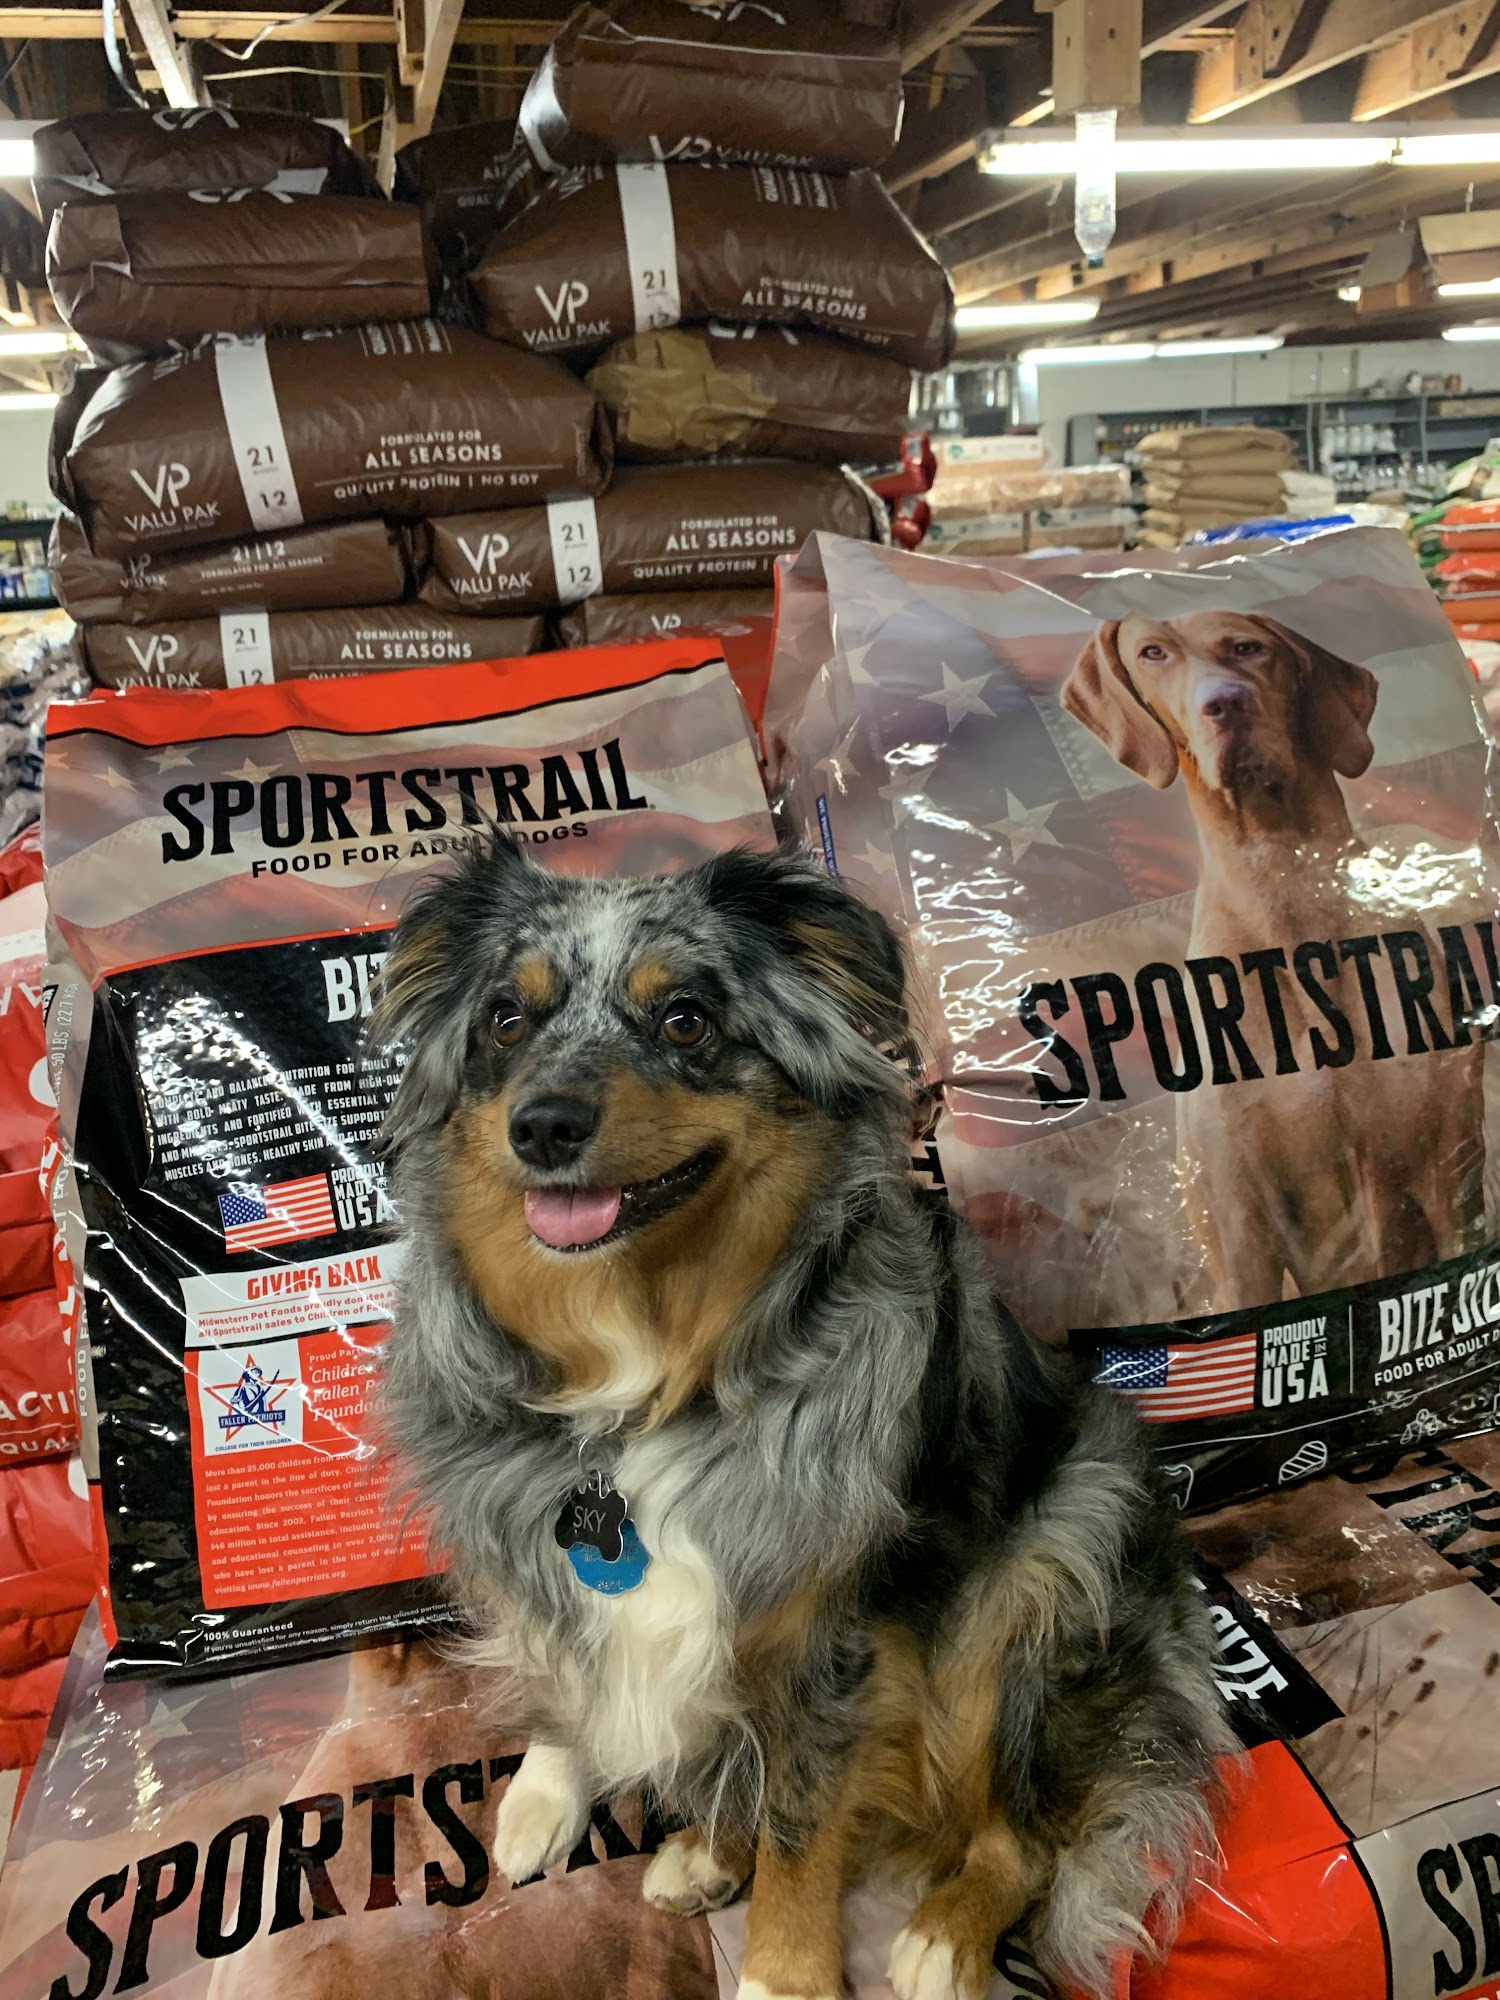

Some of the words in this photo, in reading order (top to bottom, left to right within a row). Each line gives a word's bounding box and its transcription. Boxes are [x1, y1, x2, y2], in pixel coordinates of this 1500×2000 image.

[642, 269, 667, 290] 21
[832, 284, 854, 300] FOR
[535, 280, 588, 325] VP
[740, 289, 776, 306] ALL
[782, 294, 868, 322] SEASONS
[523, 325, 571, 346] VALU
[576, 319, 612, 338] PAK
[380, 429, 455, 449] FORMULATED
[458, 428, 483, 443] FOR
[247, 445, 275, 469] 21
[365, 449, 402, 471] ALL
[409, 443, 503, 466] SEASONS
[129, 462, 191, 509] VP
[400, 472, 461, 491] PROTEIN
[481, 474, 505, 487] NO
[510, 472, 540, 487] SOY
[259, 489, 288, 510] 12
[123, 507, 177, 534] VALU
[182, 501, 223, 524] PAK
[681, 516, 753, 531] FORMULATED
[755, 515, 779, 527] FOR
[561, 522, 586, 543] 21
[666, 534, 700, 552] ALL
[707, 528, 797, 549] SEASONS
[456, 532, 510, 576] VP
[201, 563, 252, 580] FORMULATED
[253, 561, 271, 573] FOR
[273, 559, 287, 570] ALL
[288, 554, 324, 569] SEASONS
[568, 565, 593, 584] 12
[633, 562, 693, 579] QUALITY
[697, 558, 758, 574] PROTEIN
[450, 574, 493, 597] VALU
[498, 571, 533, 591] PAK
[232, 627, 257, 645] 21
[356, 629, 428, 641] FORMULATED
[431, 629, 453, 640] FOR
[126, 633, 179, 674] VP
[340, 643, 375, 660] ALL
[383, 643, 473, 660] SEASONS
[166, 671, 203, 689] PAK
[238, 668, 264, 687] 12
[161, 737, 649, 865] SPORTSTRAIL
[251, 852, 332, 879] FOOD
[343, 846, 400, 867] FOR
[52, 1028, 71, 1050] LBS.
[51, 1050, 66, 1067] 50
[206, 1085, 225, 1100] AND
[335, 1062, 355, 1075] FOR
[324, 1080, 352, 1094] FROM
[224, 1118, 243, 1133] AND
[247, 1106, 293, 1127] FORTIFIED
[327, 1095, 379, 1111] ESSENTIAL
[161, 1149, 179, 1165] AND
[233, 1125, 294, 1149] SPORTSTRAIL
[164, 1163, 204, 1182] MUSCLES
[262, 1141, 301, 1161] HEALTHY
[302, 1137, 324, 1152] SKIN
[336, 1188, 394, 1231] USA
[247, 1266, 322, 1301] GIVING
[327, 1254, 382, 1288] BACK
[198, 1315, 249, 1327] Midwestern
[250, 1310, 269, 1320] Pet
[271, 1305, 302, 1317] Foods
[213, 1322, 263, 1337] Sportstrail
[265, 1318, 292, 1329] sales
[295, 1316, 306, 1324] to
[1377, 1281, 1450, 1365] BITE
[1263, 1316, 1327, 1349] PROUDLY
[309, 1351, 337, 1364] Proud
[1263, 1344, 1310, 1369] MADE
[1374, 1364, 1414, 1387] FOOD
[1415, 1351, 1446, 1373] FOR
[1447, 1333, 1490, 1361] ADULT
[78, 1349, 88, 1417] FOOD
[311, 1363, 378, 1384] Childre
[1262, 1358, 1329, 1409] USA
[312, 1384, 360, 1403] Fallen
[220, 1416, 246, 1427] FALLEN
[215, 1444, 238, 1452] COLLEGE
[250, 1440, 265, 1448] THEIR
[266, 1437, 292, 1446] CHILDREN
[205, 1469, 226, 1478] More
[227, 1466, 246, 1475] than
[247, 1462, 276, 1473] 25,000
[278, 1457, 312, 1469] children
[313, 1455, 334, 1464] from
[206, 1483, 221, 1492] lost
[231, 1479, 258, 1491] parent
[272, 1475, 287, 1484] the
[289, 1474, 305, 1482] line
[206, 1495, 253, 1507] Foundation
[254, 1490, 283, 1501] honors
[285, 1488, 299, 1497] the
[301, 1482, 341, 1495] sacrifices
[221, 1508, 259, 1520] ensuring
[262, 1506, 276, 1515] the
[280, 1501, 313, 1512] success
[329, 1497, 350, 1506] their
[573, 1505, 607, 1534] SKY
[209, 1525, 252, 1536] education.
[256, 1520, 279, 1531] Since
[310, 1513, 337, 1524] Fallen
[340, 1507, 374, 1519] Patriots
[227, 1538, 257, 1549] million
[269, 1533, 289, 1544] total
[291, 1528, 338, 1541] assistance,
[340, 1521, 381, 1534] including
[211, 1556, 227, 1566] and
[230, 1550, 280, 1563] educational
[282, 1543, 330, 1557] counseling
[346, 1538, 365, 1548] over
[234, 1569, 255, 1578] have
[258, 1565, 274, 1575] lost
[287, 1560, 315, 1572] parent
[332, 1555, 347, 1564] the
[350, 1552, 367, 1561] line
[214, 1585, 247, 1595] visiting
[247, 1570, 349, 1591] www.fallenpatriots.org.
[203, 1631, 230, 1642] 100%
[232, 1621, 294, 1639] Guaranteed
[210, 1643, 233, 1654] you're
[234, 1636, 275, 1649] unsatisfied
[330, 1620, 354, 1632] simply
[355, 1617, 378, 1627] return
[392, 1608, 420, 1620] unused
[420, 1603, 447, 1614] portion
